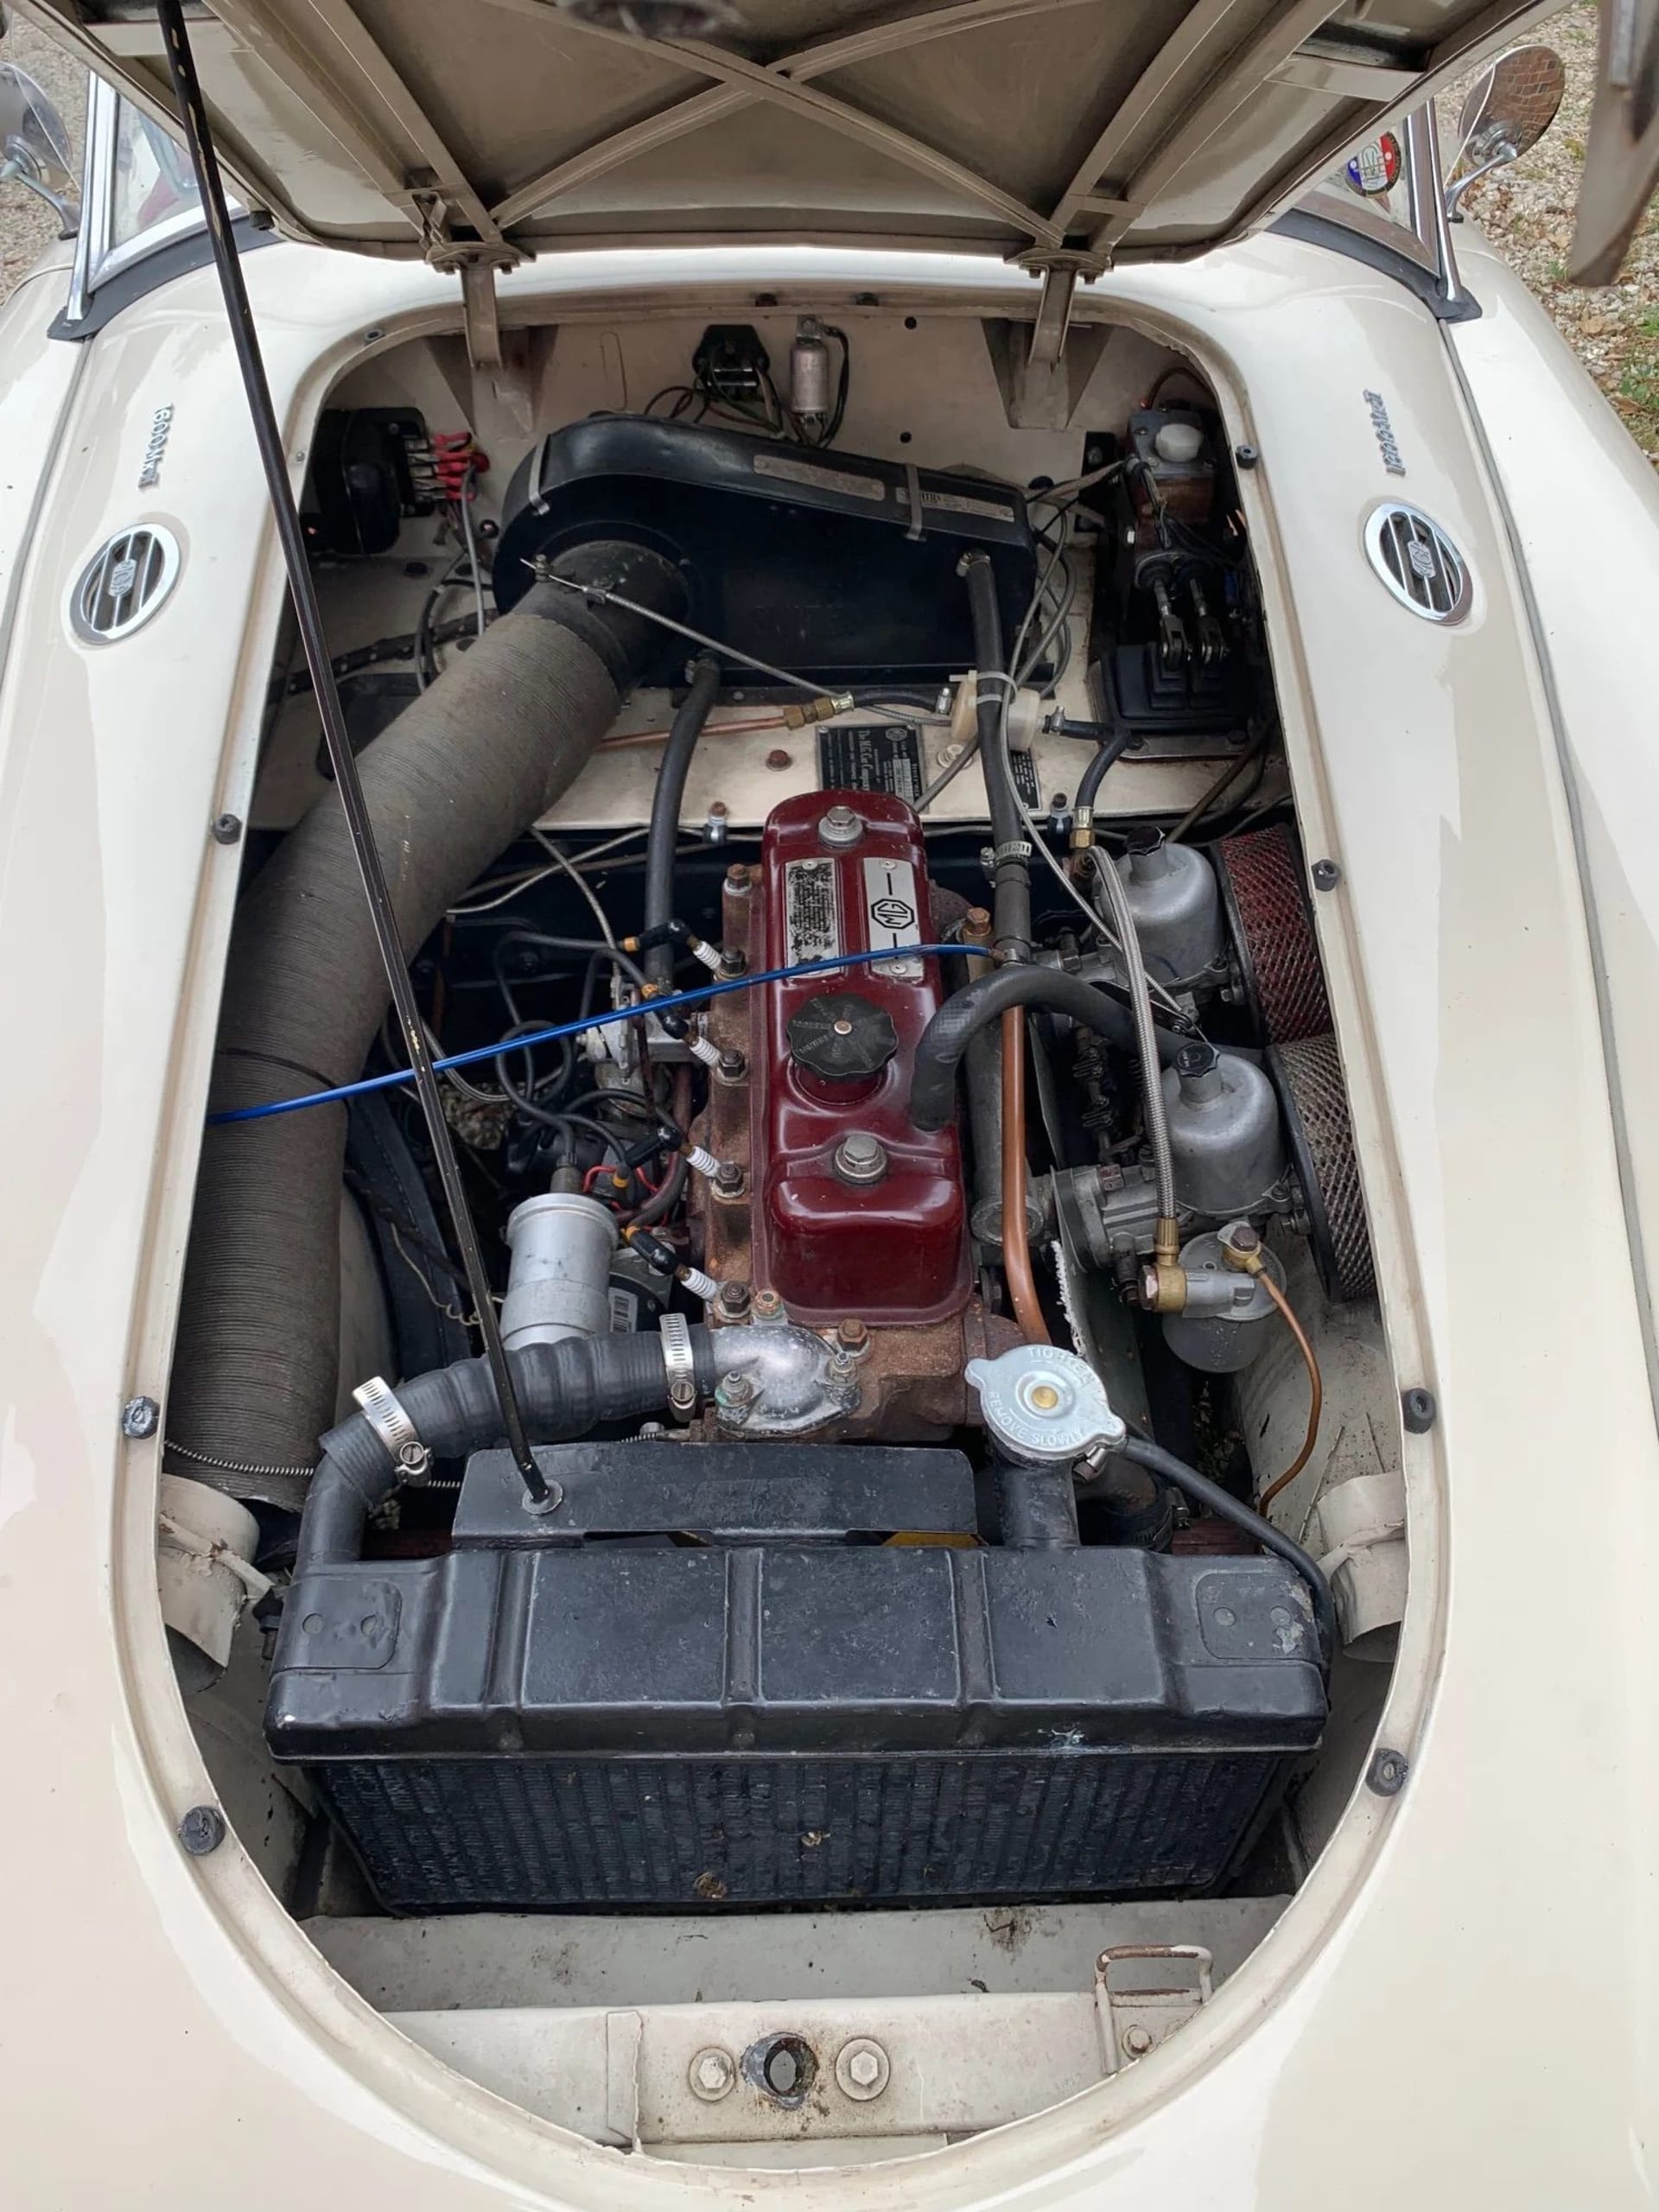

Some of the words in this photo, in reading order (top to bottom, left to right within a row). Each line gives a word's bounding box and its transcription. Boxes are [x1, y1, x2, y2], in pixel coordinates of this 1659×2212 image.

[874, 901, 911, 926] MG
[1028, 1346, 1096, 1388] TIGHTEN
[988, 1390, 1027, 1440] REMOVE
[1033, 1430, 1084, 1446] SLOWLY
